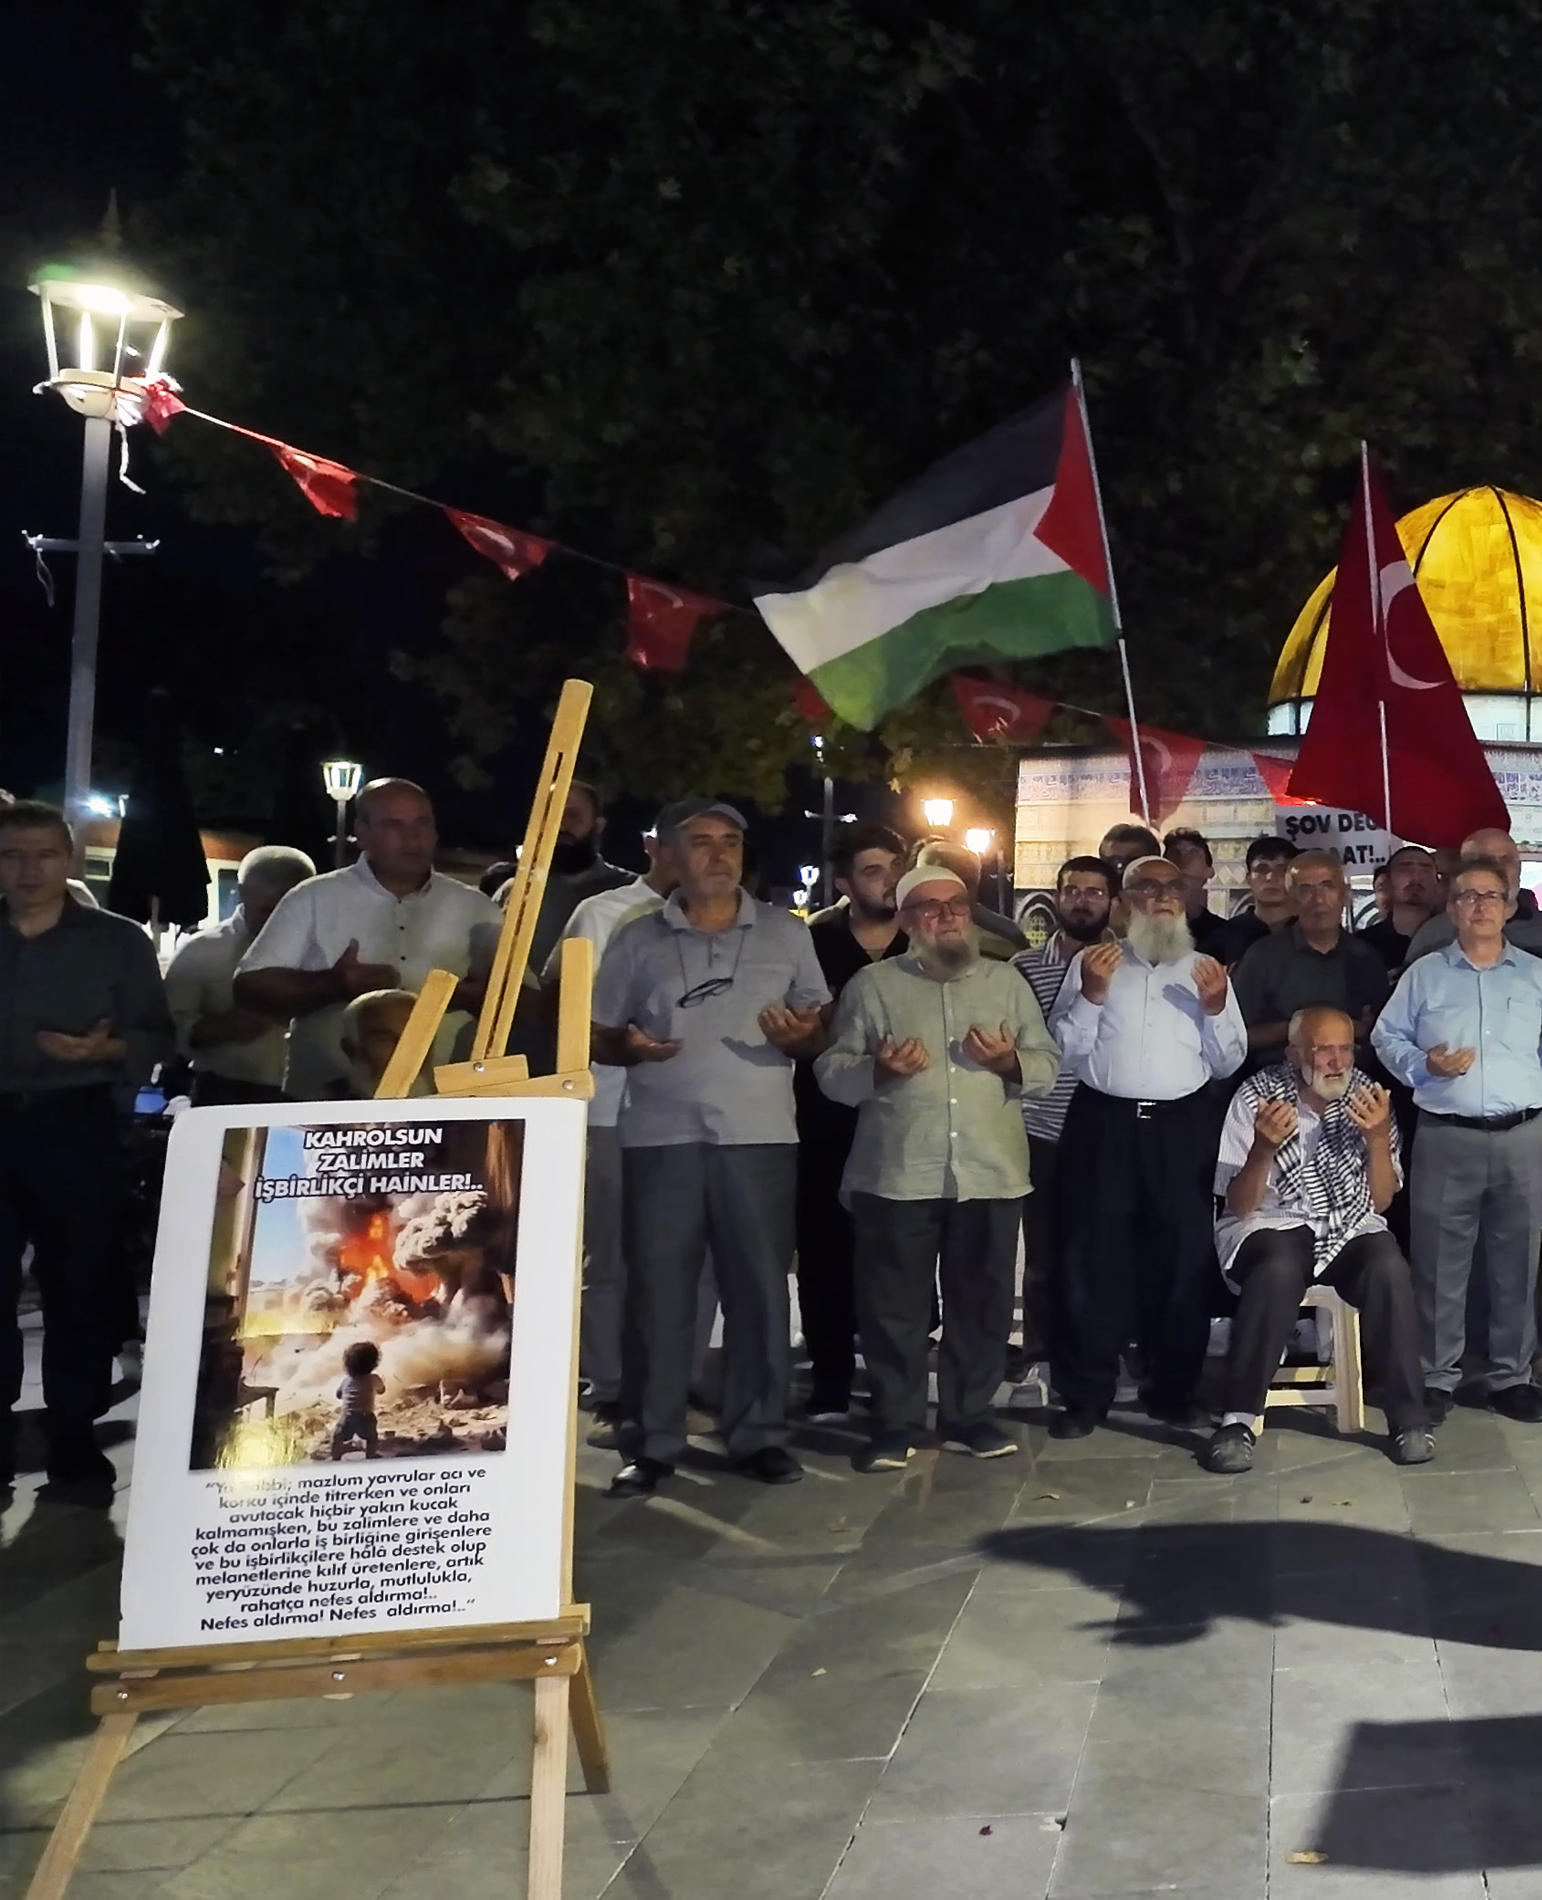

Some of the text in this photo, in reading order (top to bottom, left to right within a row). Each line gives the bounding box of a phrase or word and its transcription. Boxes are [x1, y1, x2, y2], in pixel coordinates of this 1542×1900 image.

[1285, 814, 1331, 841] ŞOV
[305, 1127, 443, 1149] KAHROLSUN
[318, 1149, 424, 1172] ZALİMLER
[255, 1171, 484, 1201] İŞBİRLİKÇİ HAİNLER!..
[298, 1474, 363, 1489] mazlum
[367, 1469, 435, 1488] yavrular
[440, 1470, 462, 1480] acı
[467, 1468, 487, 1478] ve
[272, 1490, 320, 1508] içinde
[325, 1487, 394, 1502] titrerken
[400, 1487, 418, 1497] ve
[423, 1482, 471, 1496] onları
[229, 1496, 458, 1523] avutacak hiçbir yakın kucak
[196, 1509, 490, 1541] kalmamışken, bu zalimlere ve daha
[191, 1525, 492, 1559] çok da onlarla iş birliğine girişenlere
[195, 1560, 214, 1571] ve
[220, 1556, 241, 1569] bu
[246, 1550, 345, 1570] işbirlikçilere
[392, 1540, 445, 1557] destek
[451, 1540, 486, 1556] olup
[196, 1555, 484, 1586] melanetlerine kılıf üretenlere, artık
[206, 1570, 472, 1604] yeryüzünde huzurla, mutlulukla,
[240, 1599, 304, 1613] rahatça
[309, 1593, 353, 1608] nefes
[201, 1615, 249, 1632] Nefes
[253, 1609, 324, 1627] aldırma!
[330, 1607, 377, 1621] Nefes
